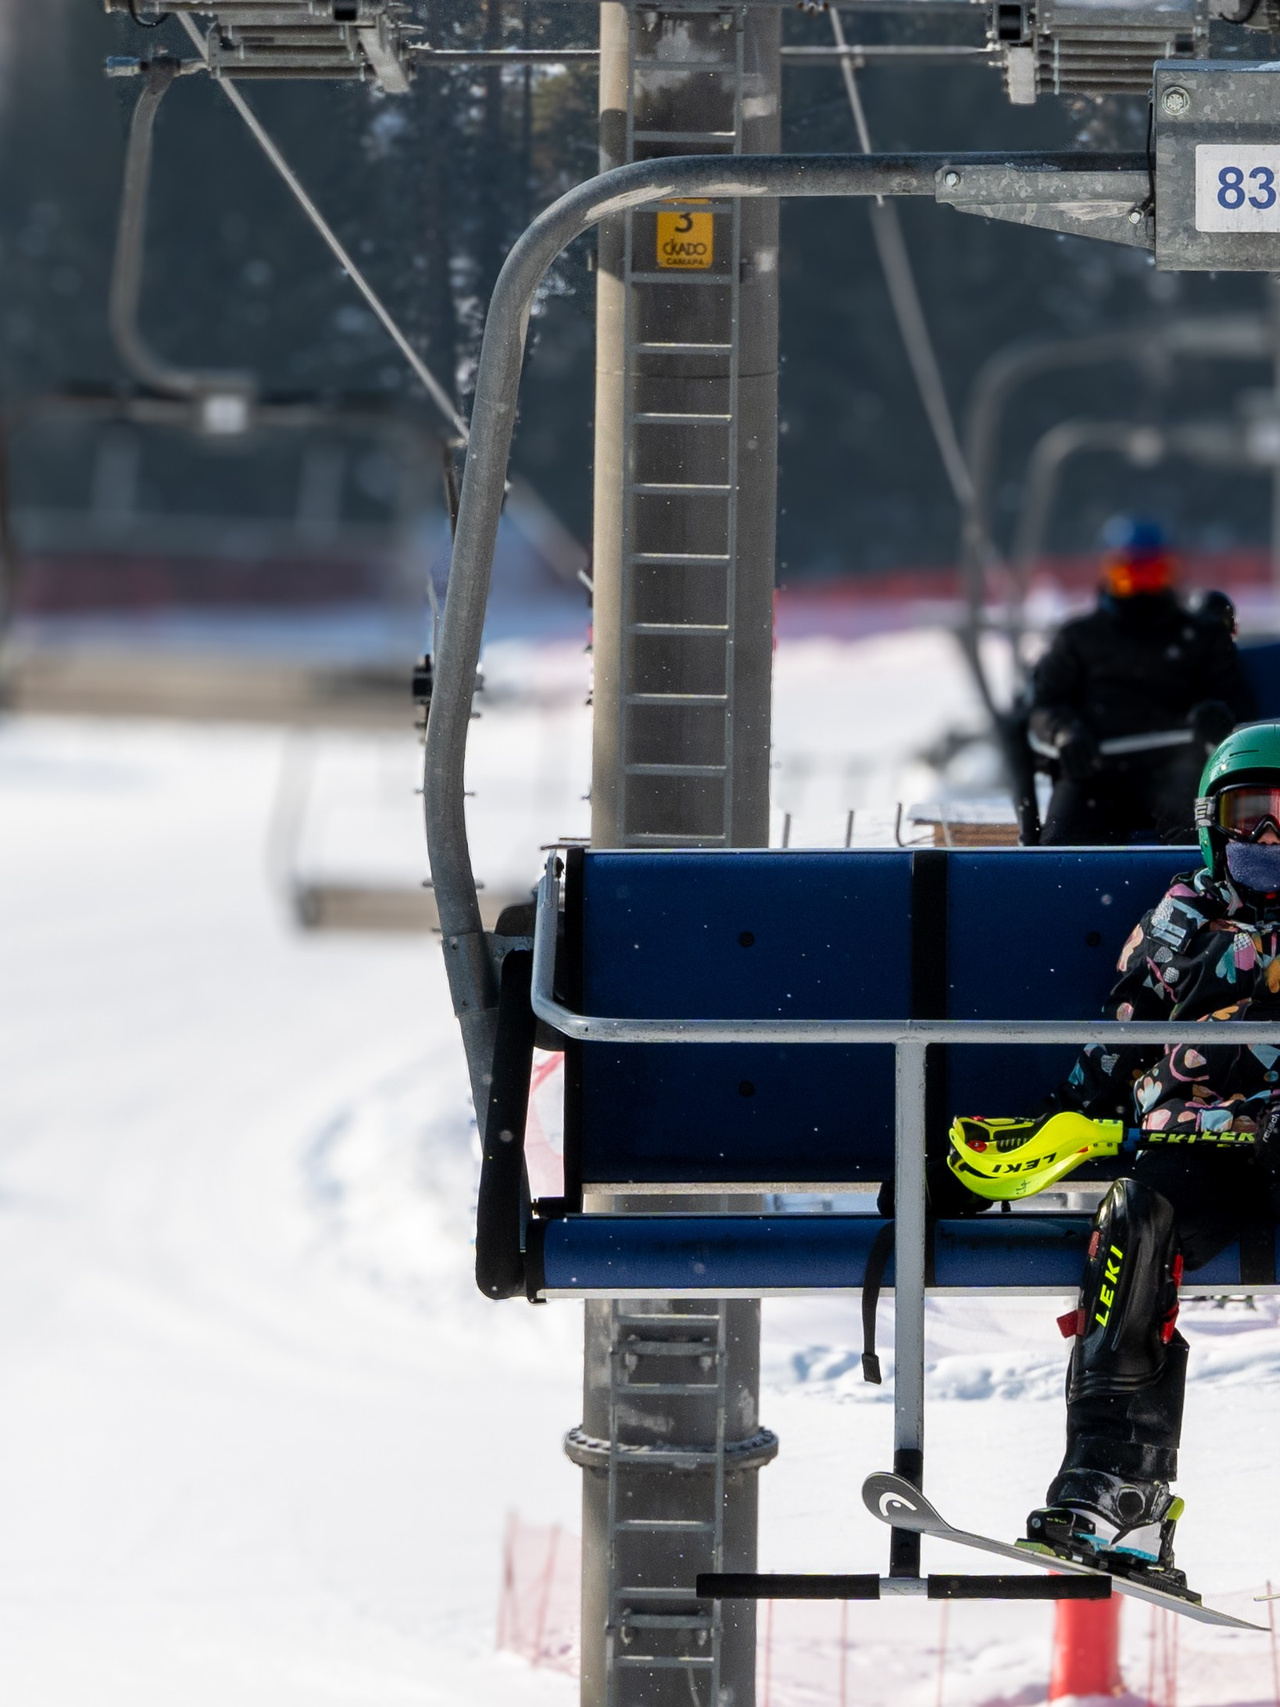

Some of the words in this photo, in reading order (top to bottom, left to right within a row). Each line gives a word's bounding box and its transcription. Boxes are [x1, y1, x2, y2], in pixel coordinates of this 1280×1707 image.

[1217, 166, 1277, 210] 83
[675, 212, 693, 233] 3
[1262, 1113, 1280, 1143] reusch
[992, 1152, 1057, 1174] LEKI
[1095, 1245, 1124, 1328] LEKI
